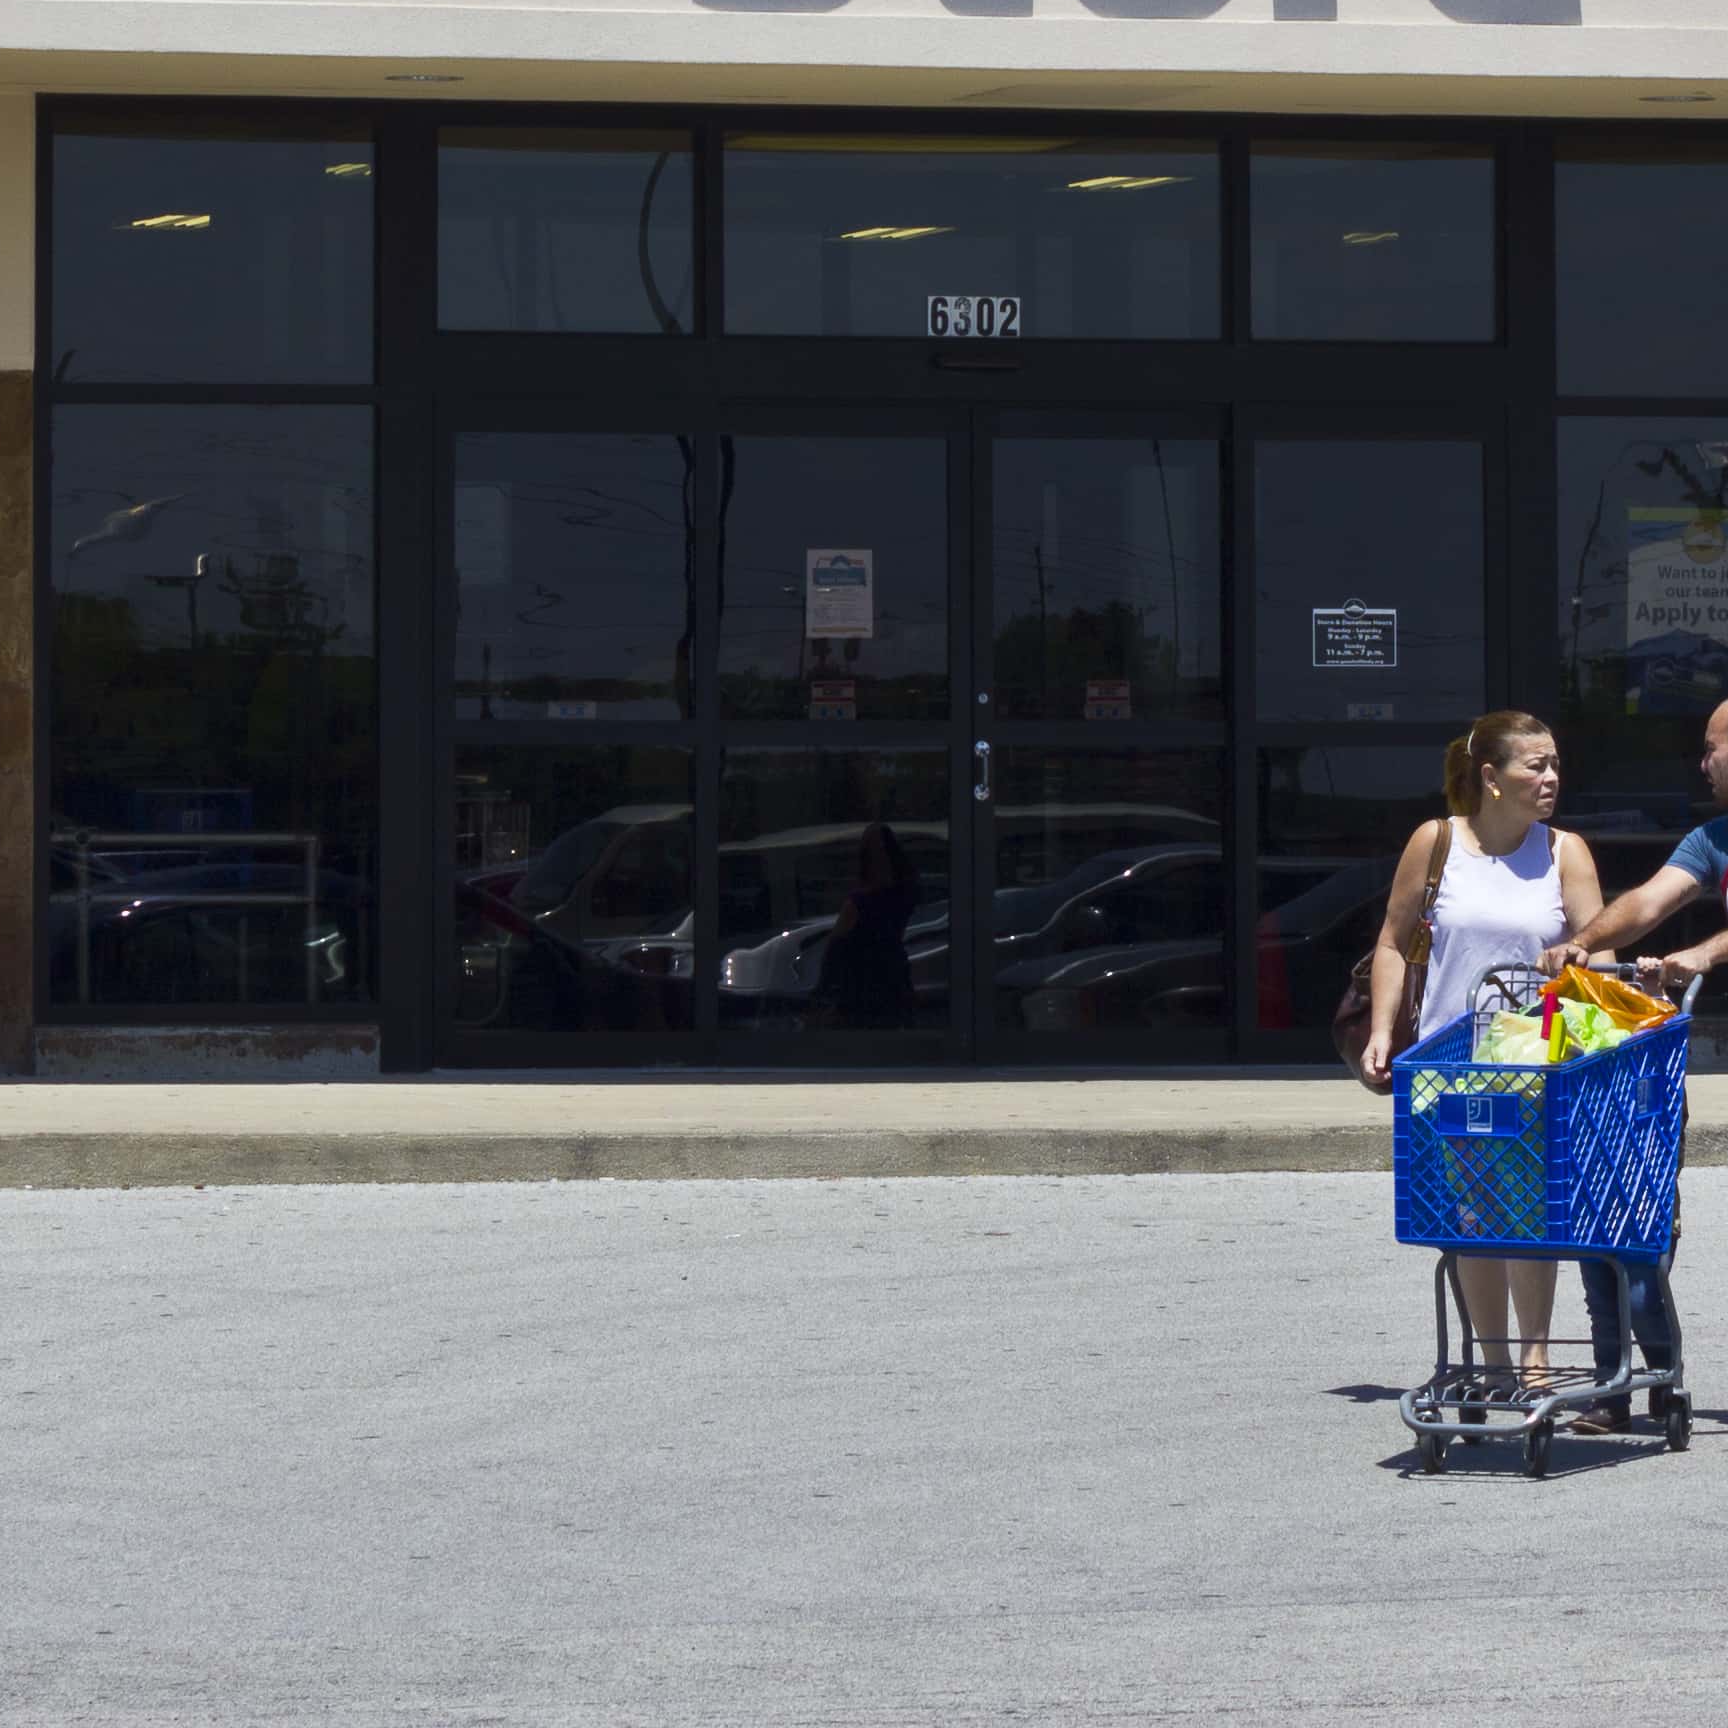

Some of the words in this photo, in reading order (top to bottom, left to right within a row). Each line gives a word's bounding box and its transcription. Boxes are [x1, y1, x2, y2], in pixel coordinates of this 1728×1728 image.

[930, 296, 1018, 337] 6302
[1657, 564, 1697, 579] Want
[1701, 567, 1717, 579] to
[1664, 585, 1690, 598] our
[1634, 601, 1701, 627] Apply
